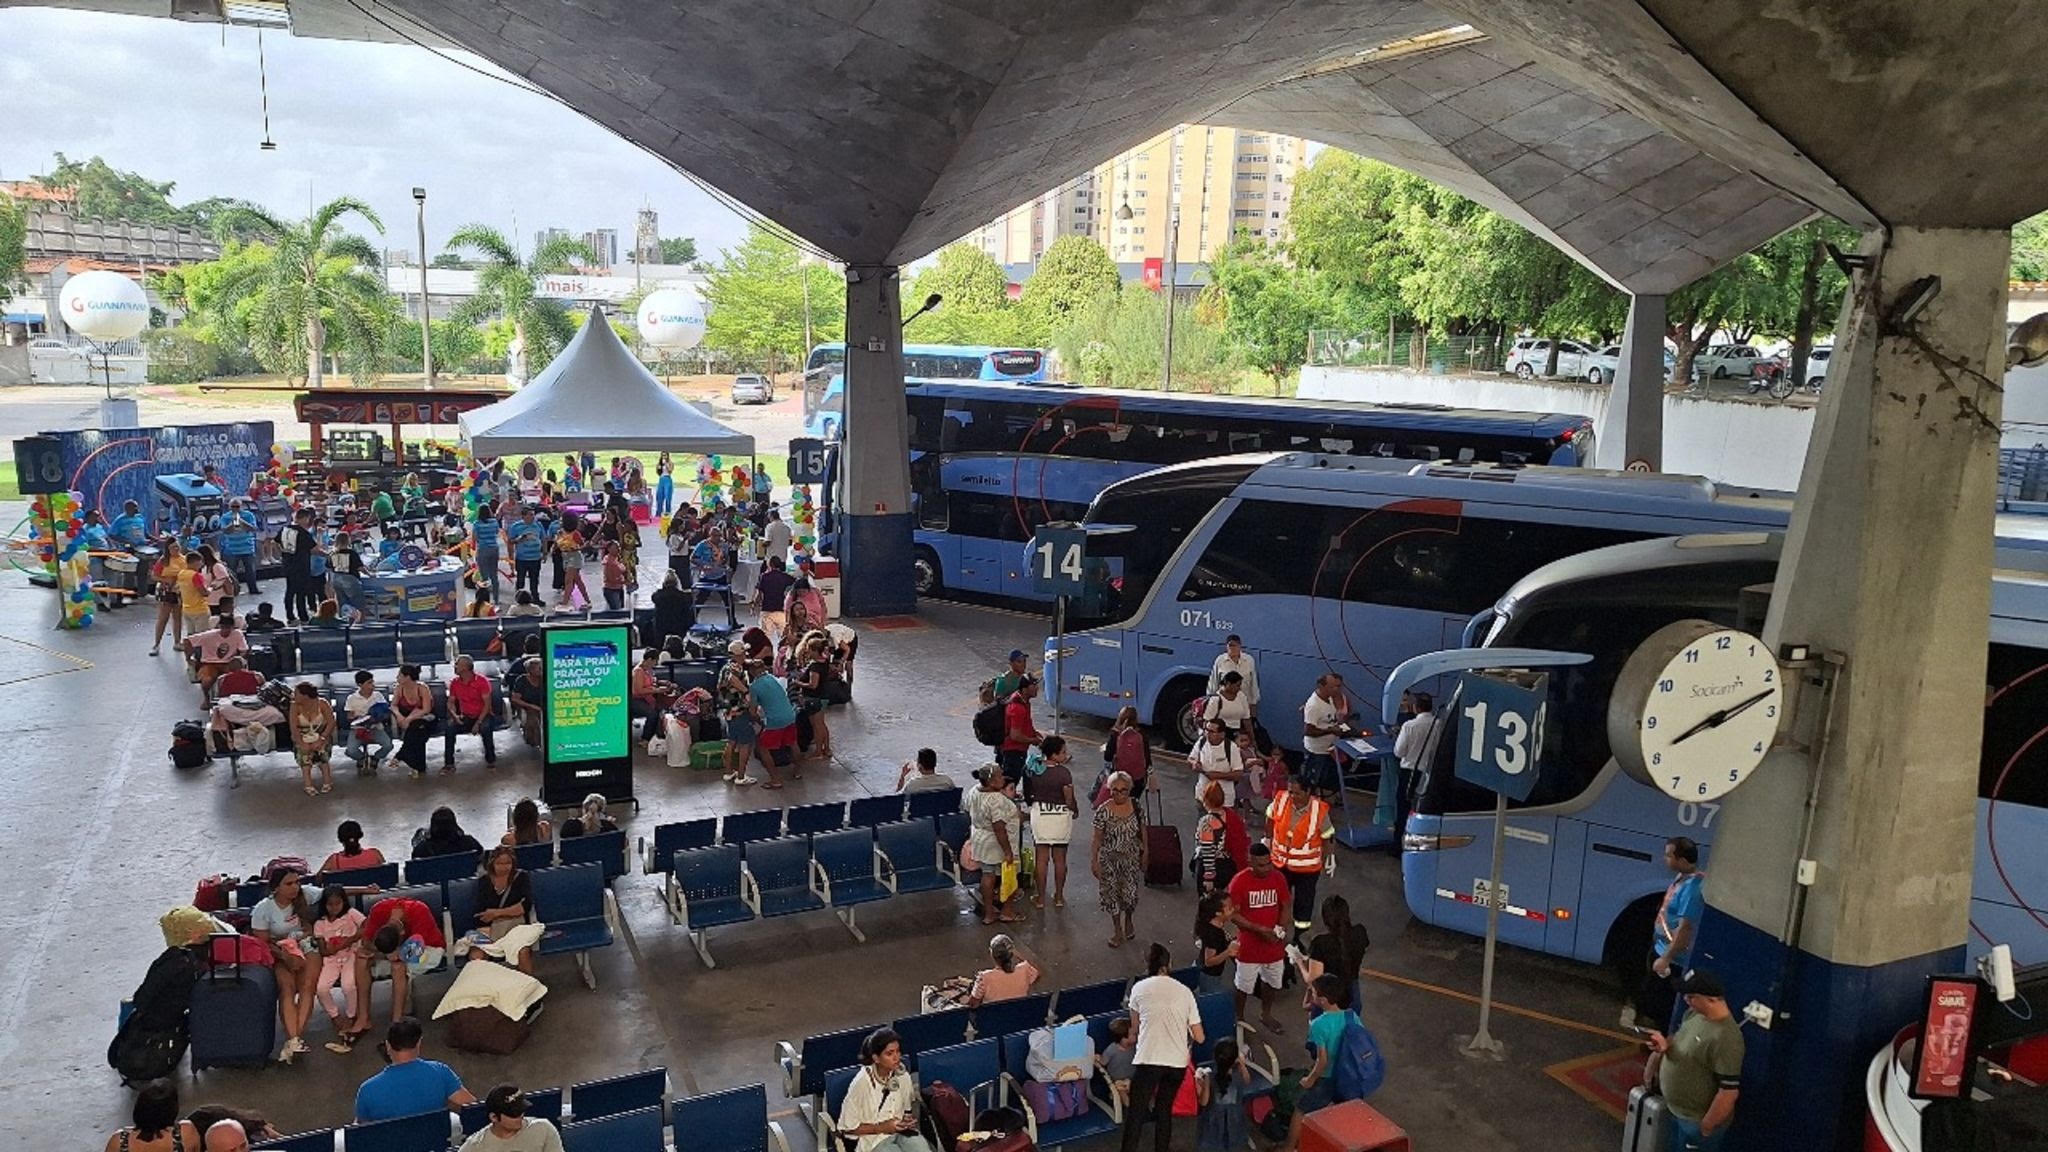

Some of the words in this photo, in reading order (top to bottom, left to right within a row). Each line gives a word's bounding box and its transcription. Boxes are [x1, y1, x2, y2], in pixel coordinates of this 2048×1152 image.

[24, 450, 64, 483] 18
[791, 448, 824, 476] 15
[1037, 541, 1083, 582] 14
[1180, 609, 1211, 628] 071
[1715, 636, 1731, 650] 12
[1684, 649, 1699, 663] 11
[1749, 645, 1755, 657] 1
[1764, 669, 1774, 683] 2
[1658, 679, 1674, 693] 10
[1766, 705, 1775, 718] 3
[1647, 716, 1657, 729] 9
[1464, 701, 1528, 775] 13
[1753, 741, 1763, 753] 4
[1652, 752, 1661, 765] 8
[1672, 776, 1680, 789] 7
[1729, 769, 1738, 782] 5
[1698, 782, 1707, 795] 6
